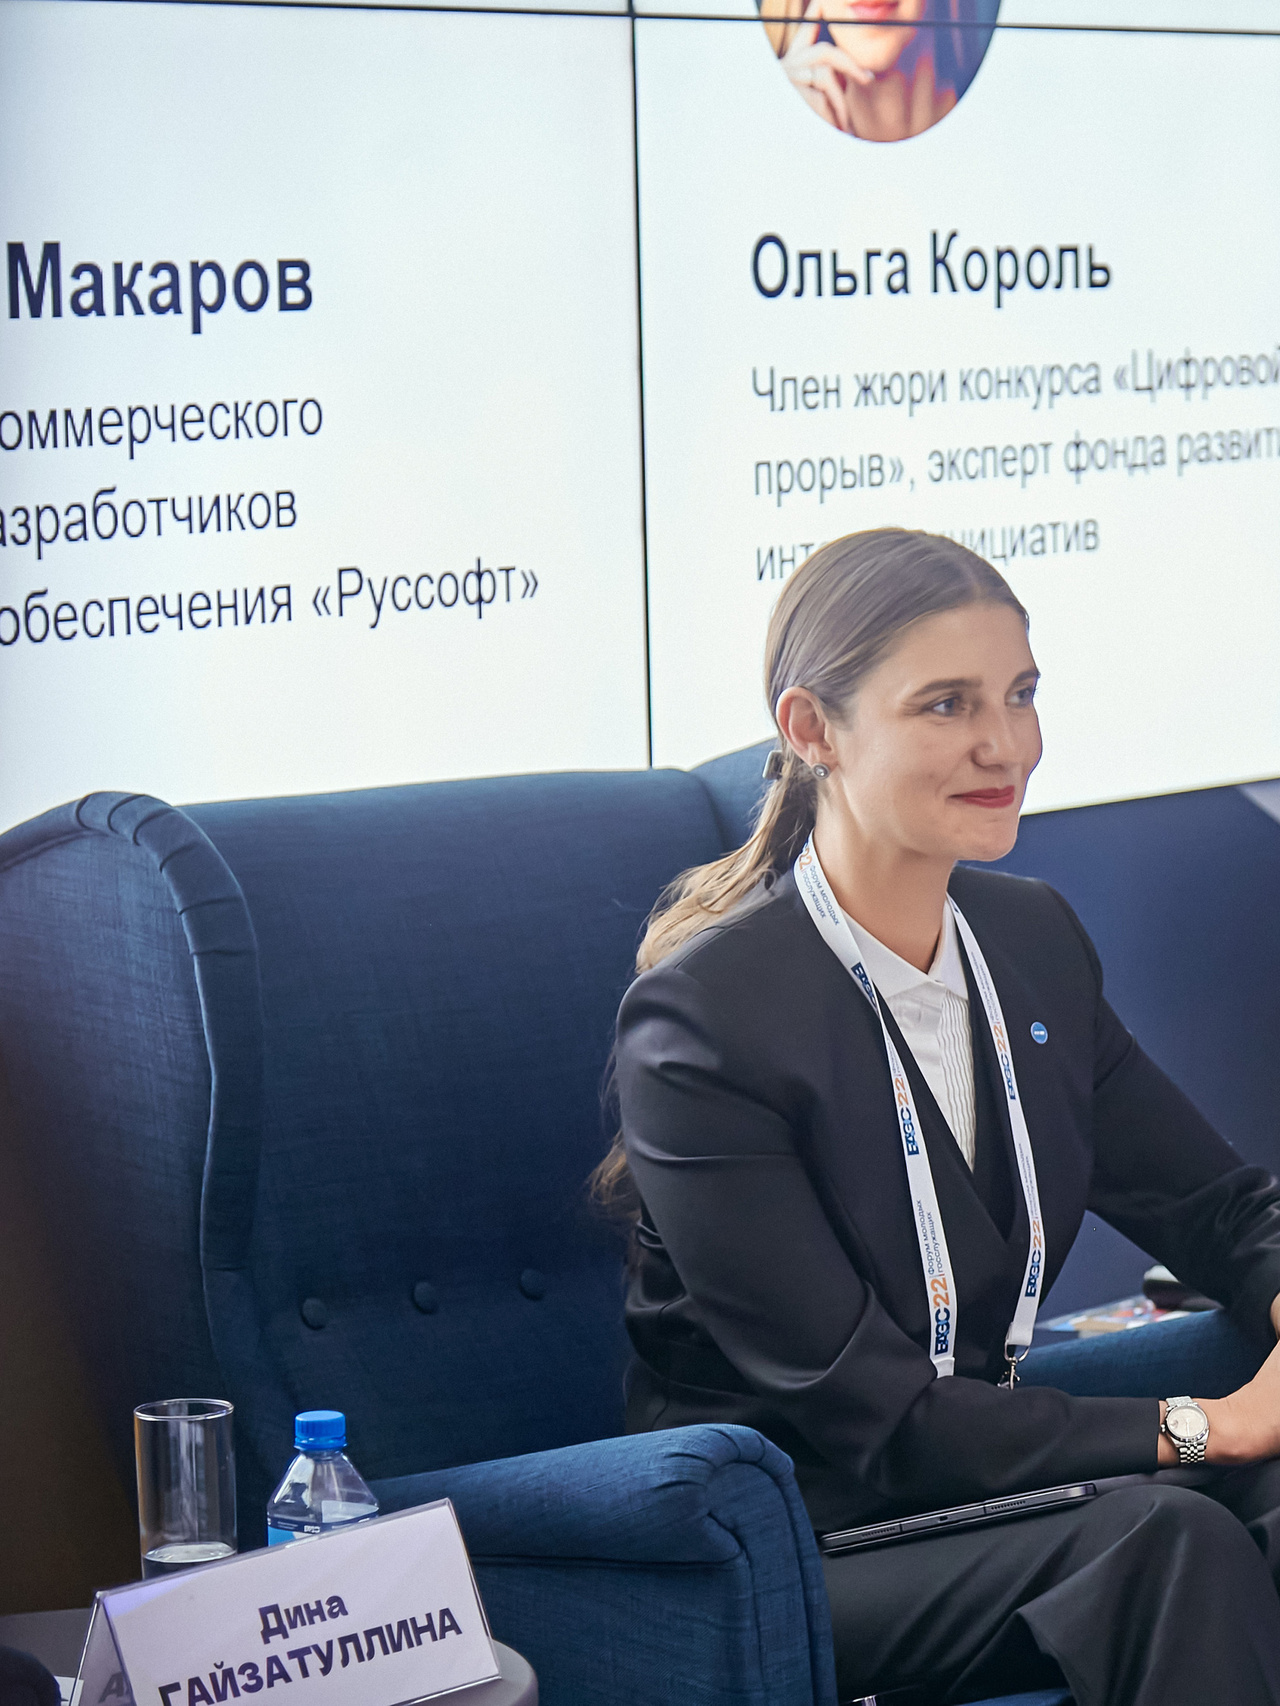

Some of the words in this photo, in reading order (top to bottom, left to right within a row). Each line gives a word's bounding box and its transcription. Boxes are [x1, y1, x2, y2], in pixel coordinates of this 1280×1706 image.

[7, 241, 313, 335] Макаров
[751, 232, 911, 299] Ольга
[930, 229, 1113, 309] Король
[752, 365, 842, 412] Член
[854, 370, 948, 418] жюри
[959, 361, 1103, 410] конкурса
[0, 398, 323, 460] оммерческого
[754, 452, 916, 508] прорыв»,
[928, 440, 1054, 490] эксперт
[1064, 430, 1168, 485] фонда
[0, 584, 293, 648] обеспечения
[312, 556, 540, 629] «Руссофт»
[820, 890, 840, 926] молодых
[916, 1199, 930, 1241] молодых
[925, 1212, 944, 1273] госслужащих
[922, 1241, 935, 1275] Форум
[258, 1595, 349, 1645] Дина
[158, 1607, 463, 1706] ГАЙЗАТУЛЛИНА
